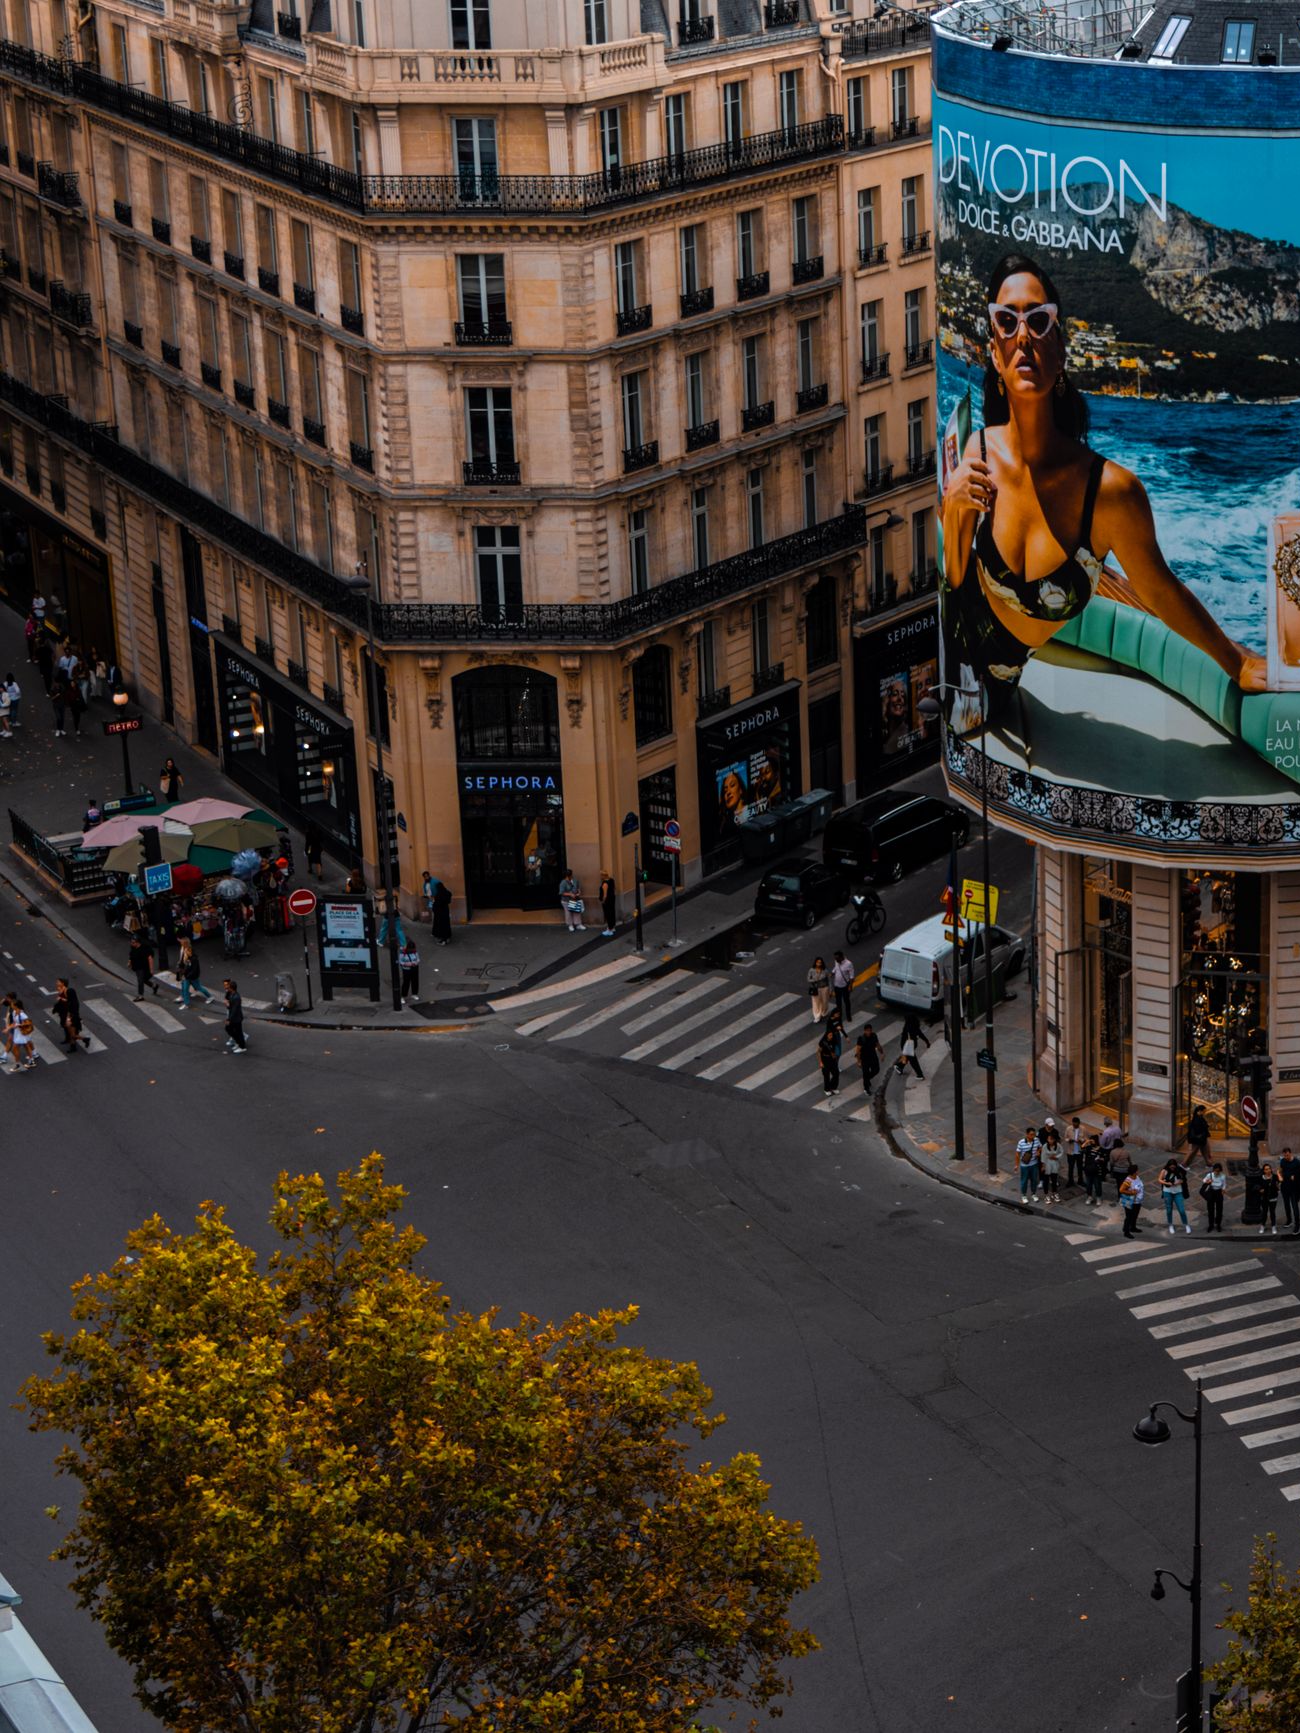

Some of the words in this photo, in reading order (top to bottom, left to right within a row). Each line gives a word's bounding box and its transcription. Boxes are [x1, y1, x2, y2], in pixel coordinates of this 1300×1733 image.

[938, 124, 1167, 222] DEVOTION
[958, 198, 1000, 235] DOLCE
[1002, 224, 1010, 238] &
[1011, 214, 1124, 254] GABBANA
[887, 615, 936, 646] SEPHORA
[227, 658, 260, 689] SEPHORA
[295, 705, 330, 736] SEPHORA
[725, 705, 780, 741] SEPHORA
[1276, 719, 1292, 732] LA
[1266, 738, 1294, 751] EAU
[464, 775, 556, 789] SEPHORA
[149, 872, 169, 884] TAXIS
